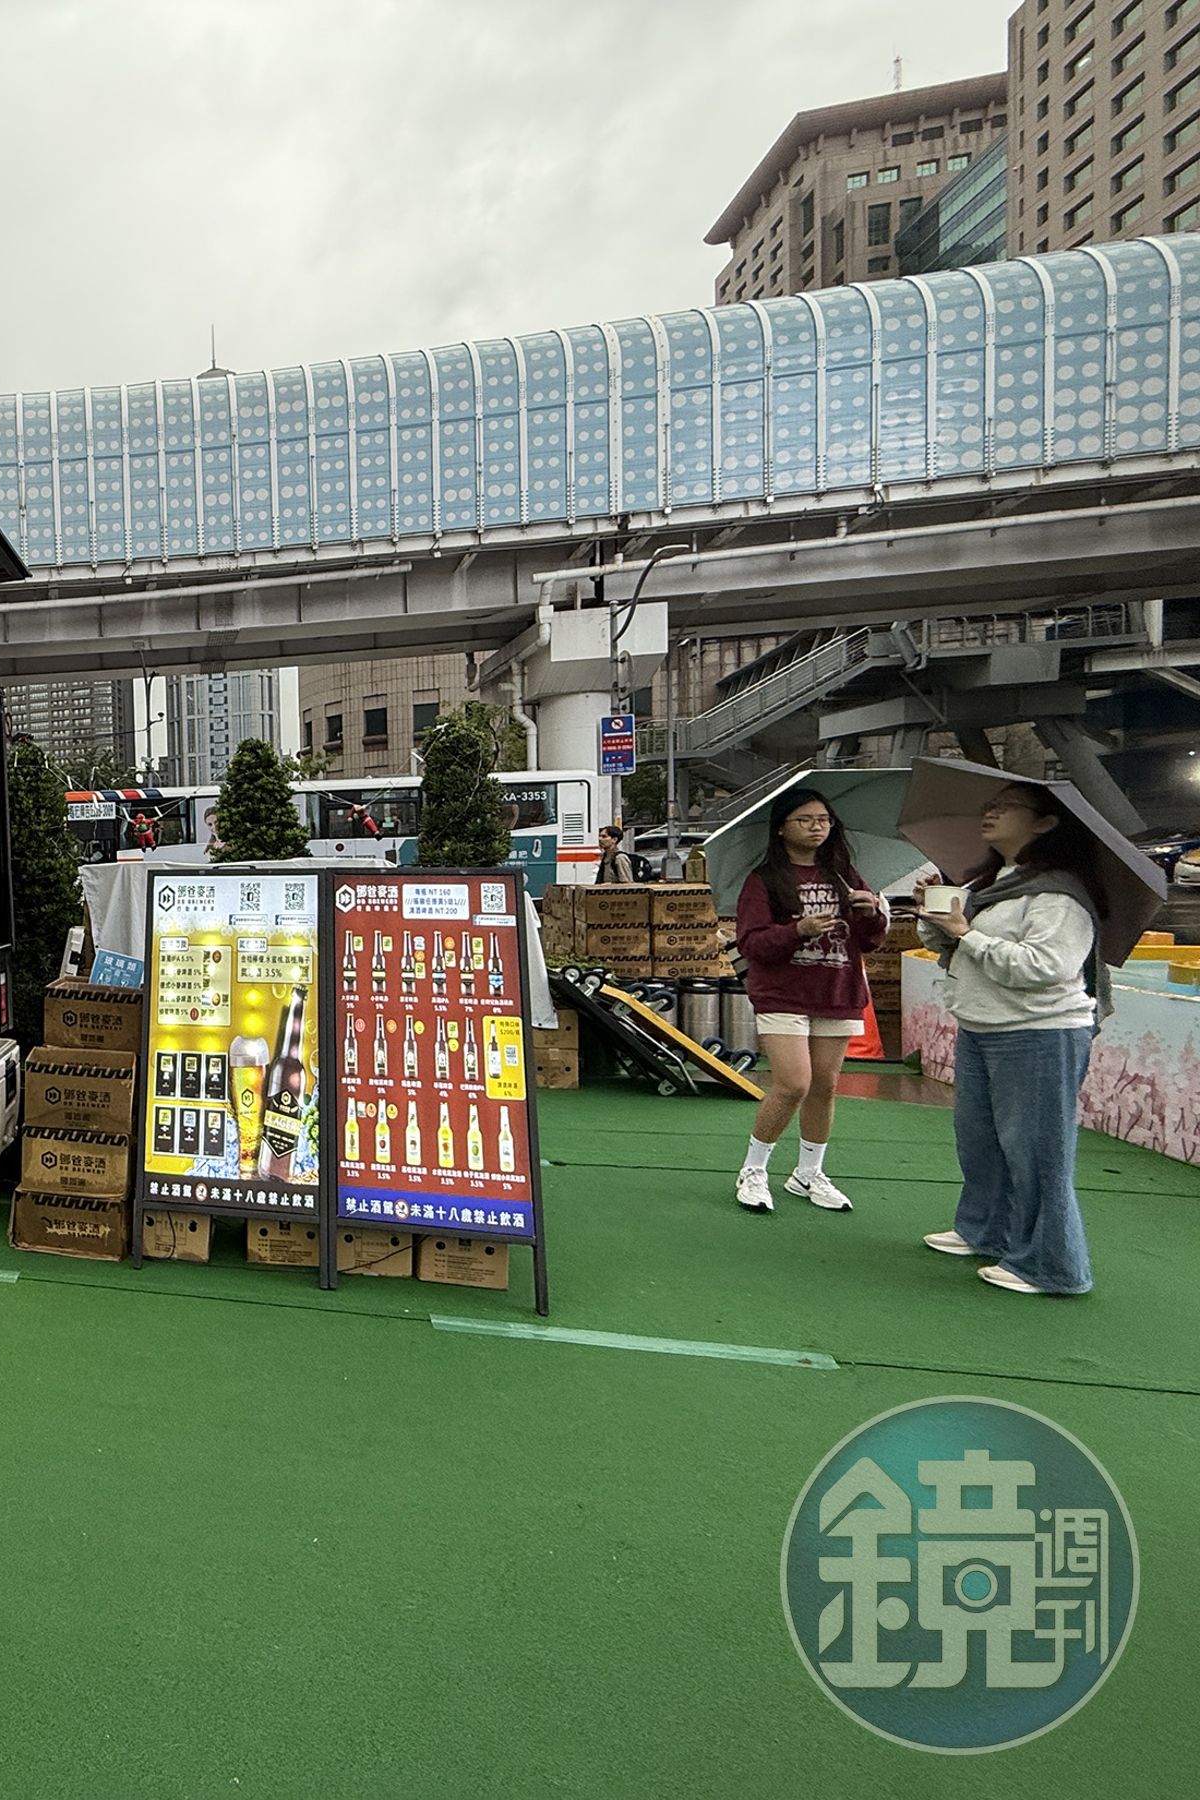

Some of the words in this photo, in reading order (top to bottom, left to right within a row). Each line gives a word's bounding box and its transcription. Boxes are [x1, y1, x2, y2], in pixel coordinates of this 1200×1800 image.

[177, 885, 215, 898] 鄧爸麥酒
[356, 885, 398, 898] 鄧爸麥酒
[265, 968, 282, 977] 3.5%
[64, 1089, 111, 1103] 鄧爸麥酒
[59, 1153, 106, 1169] 鄧爸麥酒
[150, 1181, 192, 1197] 禁止酒駕
[210, 1187, 314, 1208] 未滿十八歲禁止飲酒
[346, 1197, 394, 1215] 禁止酒駕
[410, 1204, 526, 1228] 未滿十八歲禁止飲酒
